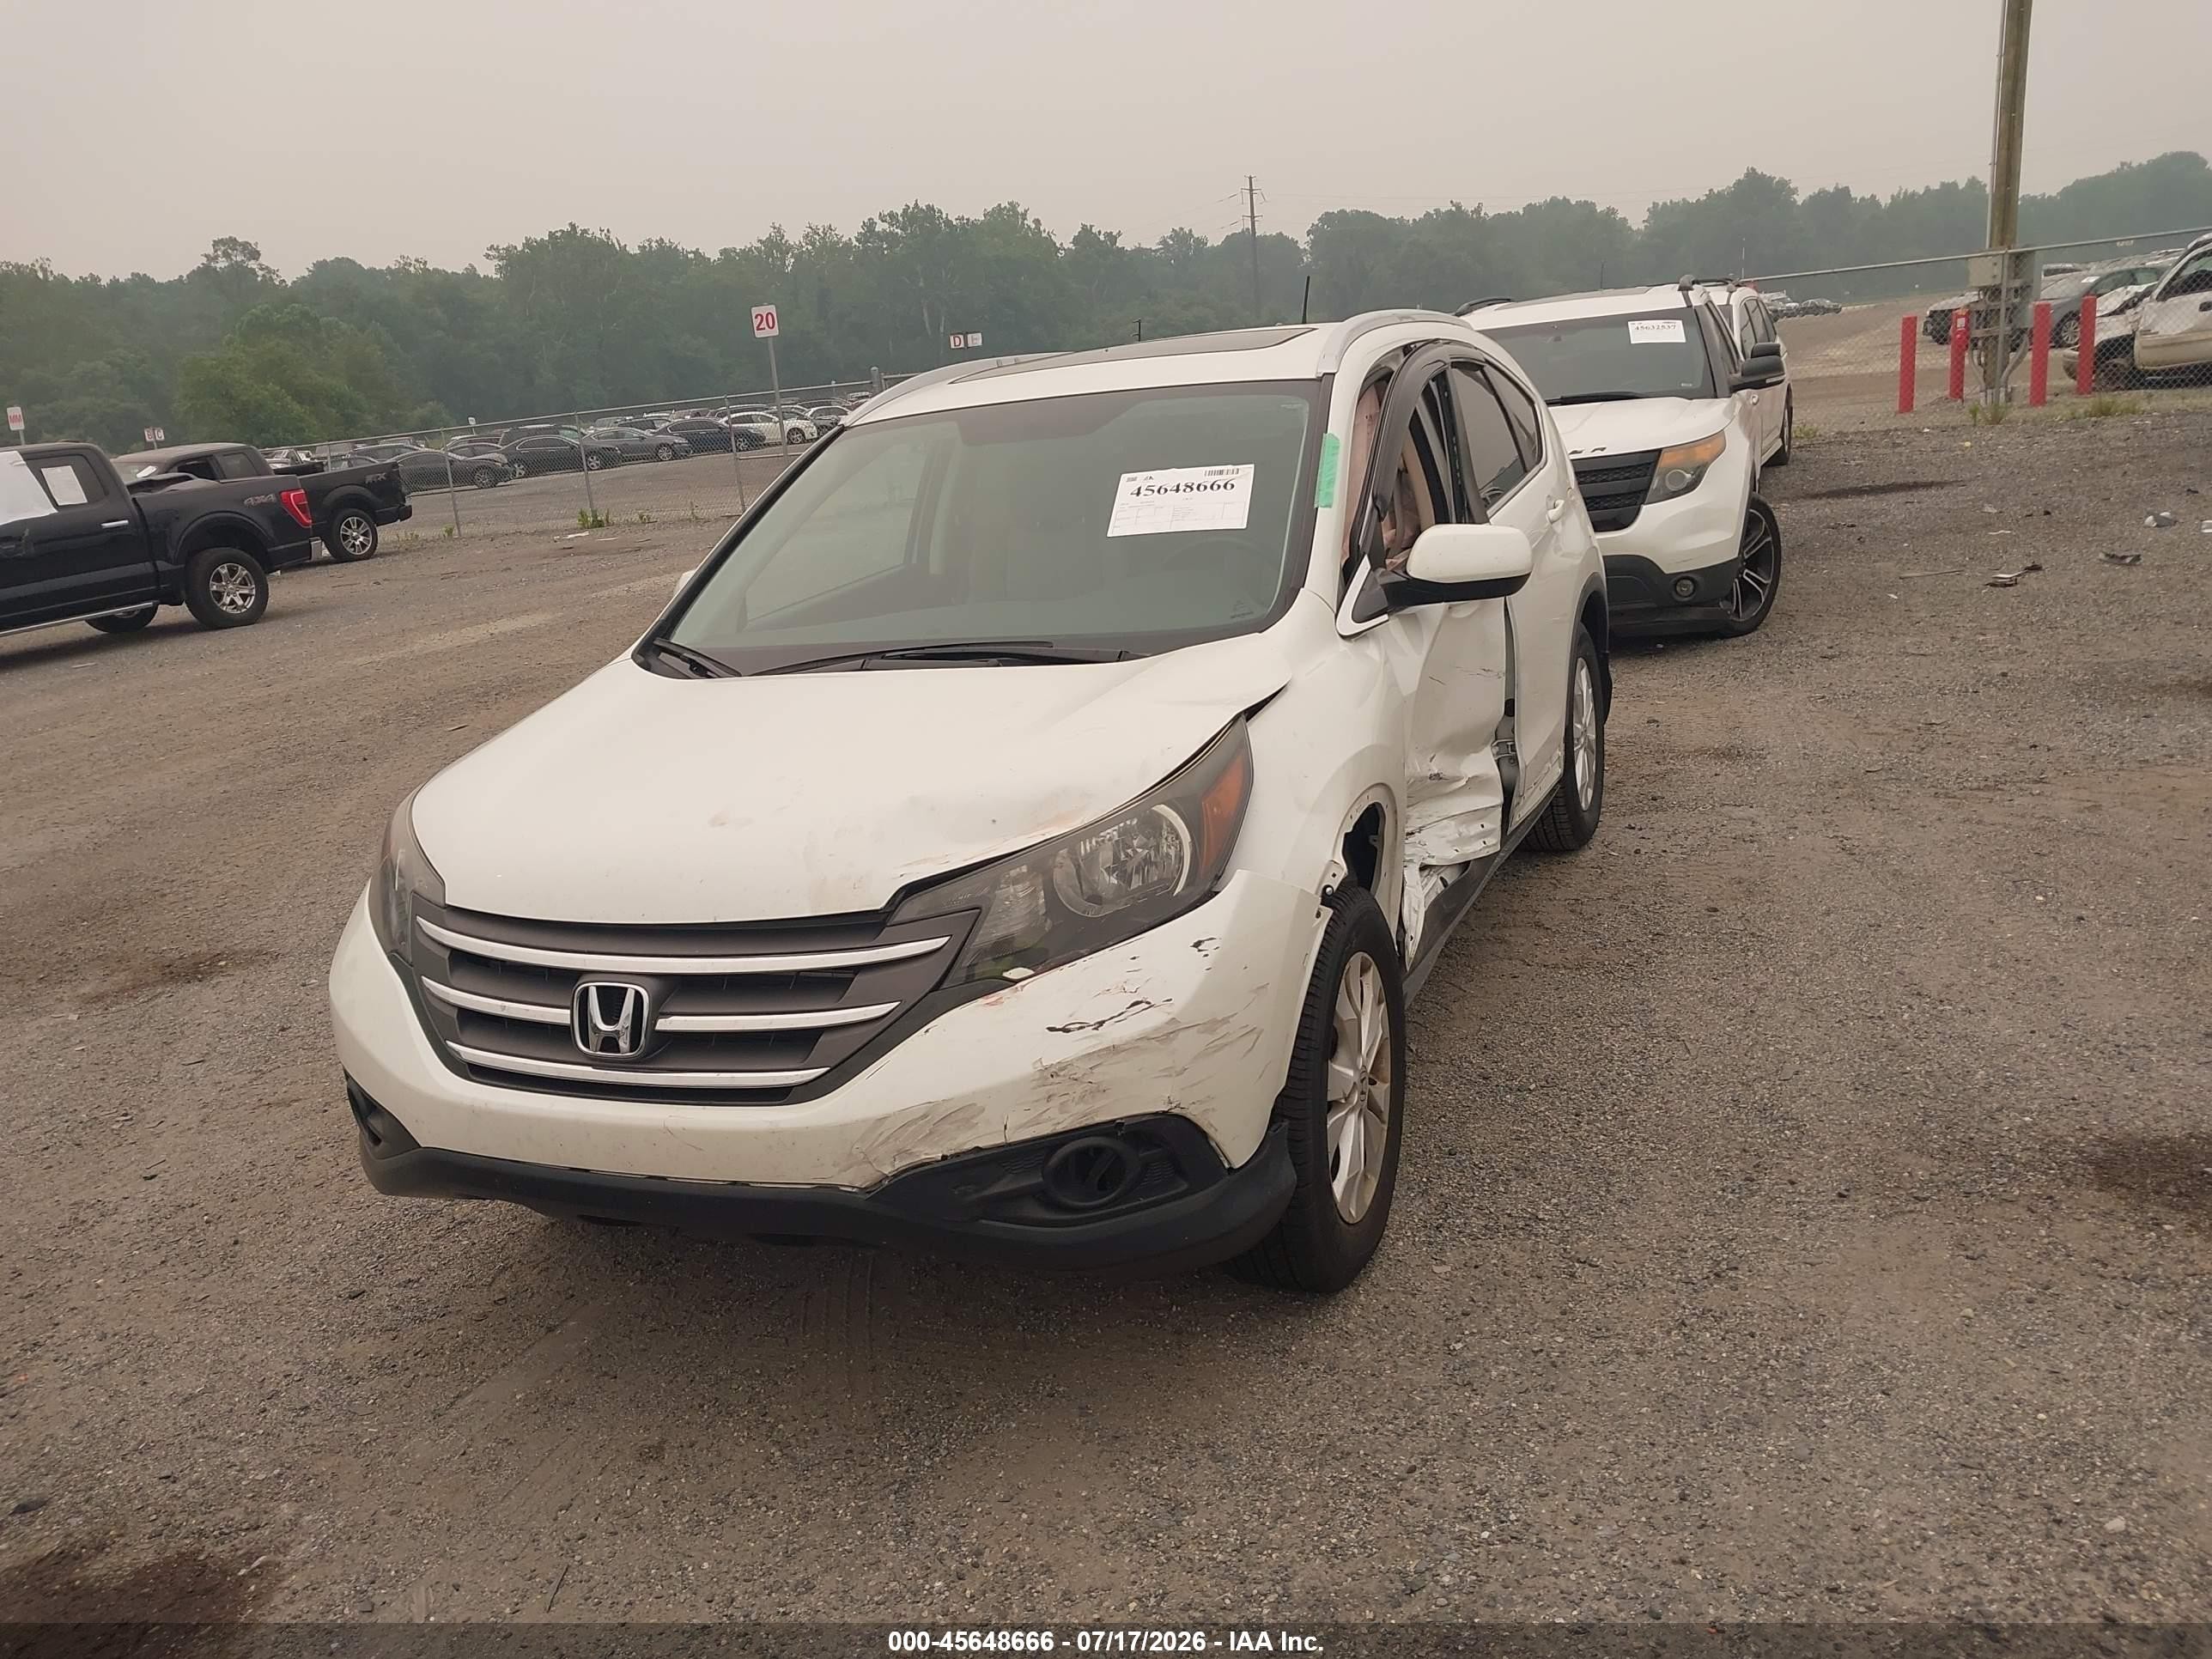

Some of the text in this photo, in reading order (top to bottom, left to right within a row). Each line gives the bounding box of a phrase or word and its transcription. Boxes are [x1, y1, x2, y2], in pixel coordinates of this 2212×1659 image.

[755, 312, 775, 331] 20
[953, 336, 962, 347] D
[1130, 478, 1237, 497] 45648666
